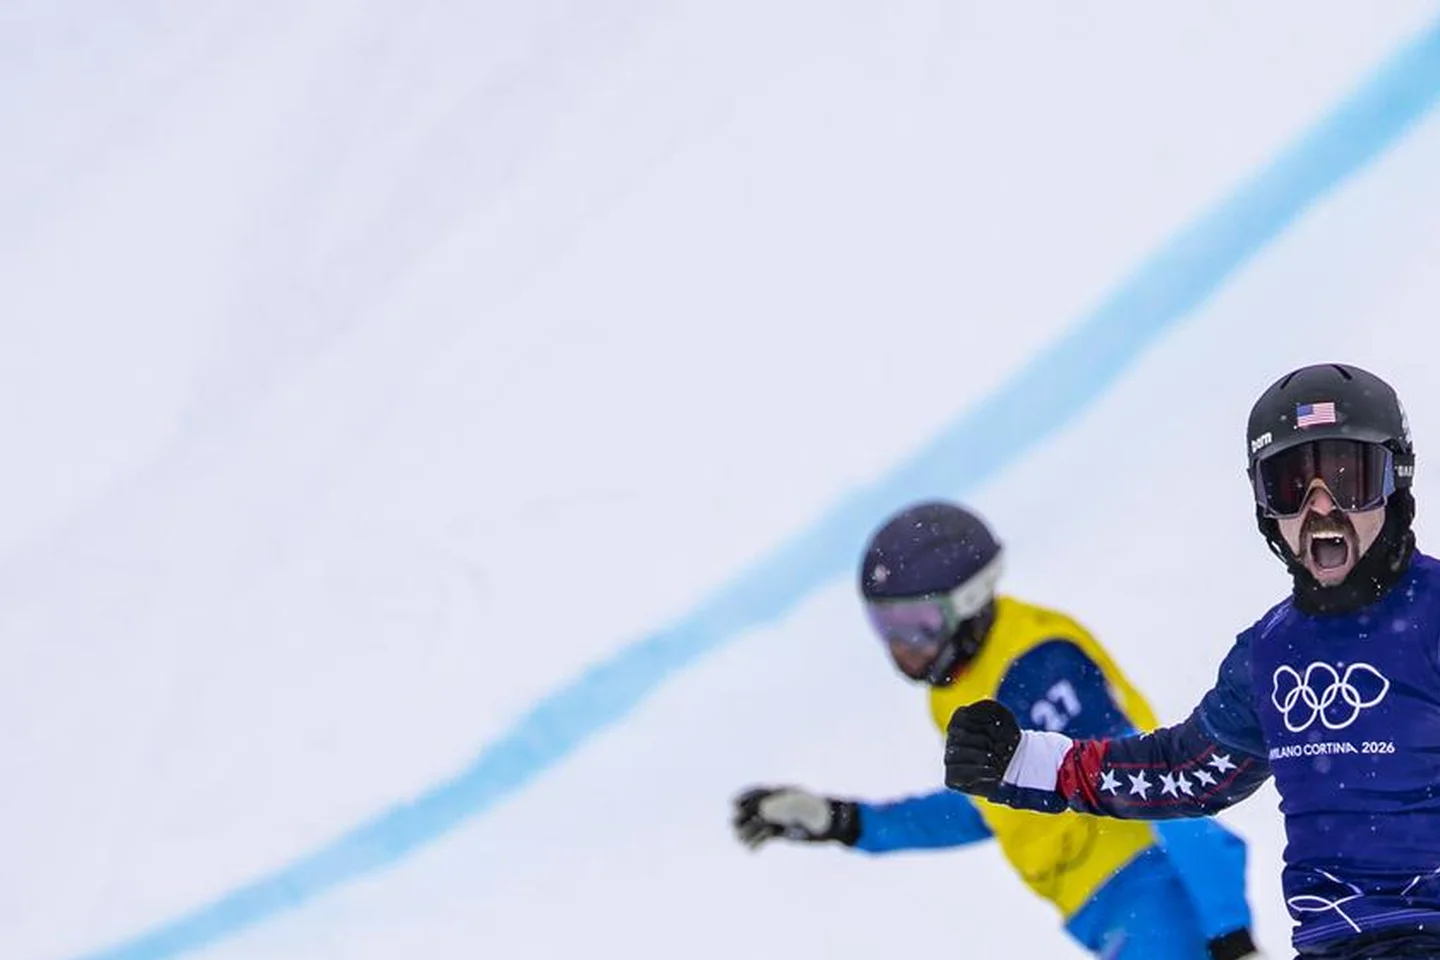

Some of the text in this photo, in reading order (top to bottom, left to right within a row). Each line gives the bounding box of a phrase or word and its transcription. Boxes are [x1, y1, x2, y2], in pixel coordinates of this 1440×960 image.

[1031, 680, 1081, 731] 27
[1303, 743, 1358, 756] CORTINA
[1362, 742, 1395, 753] 2026
